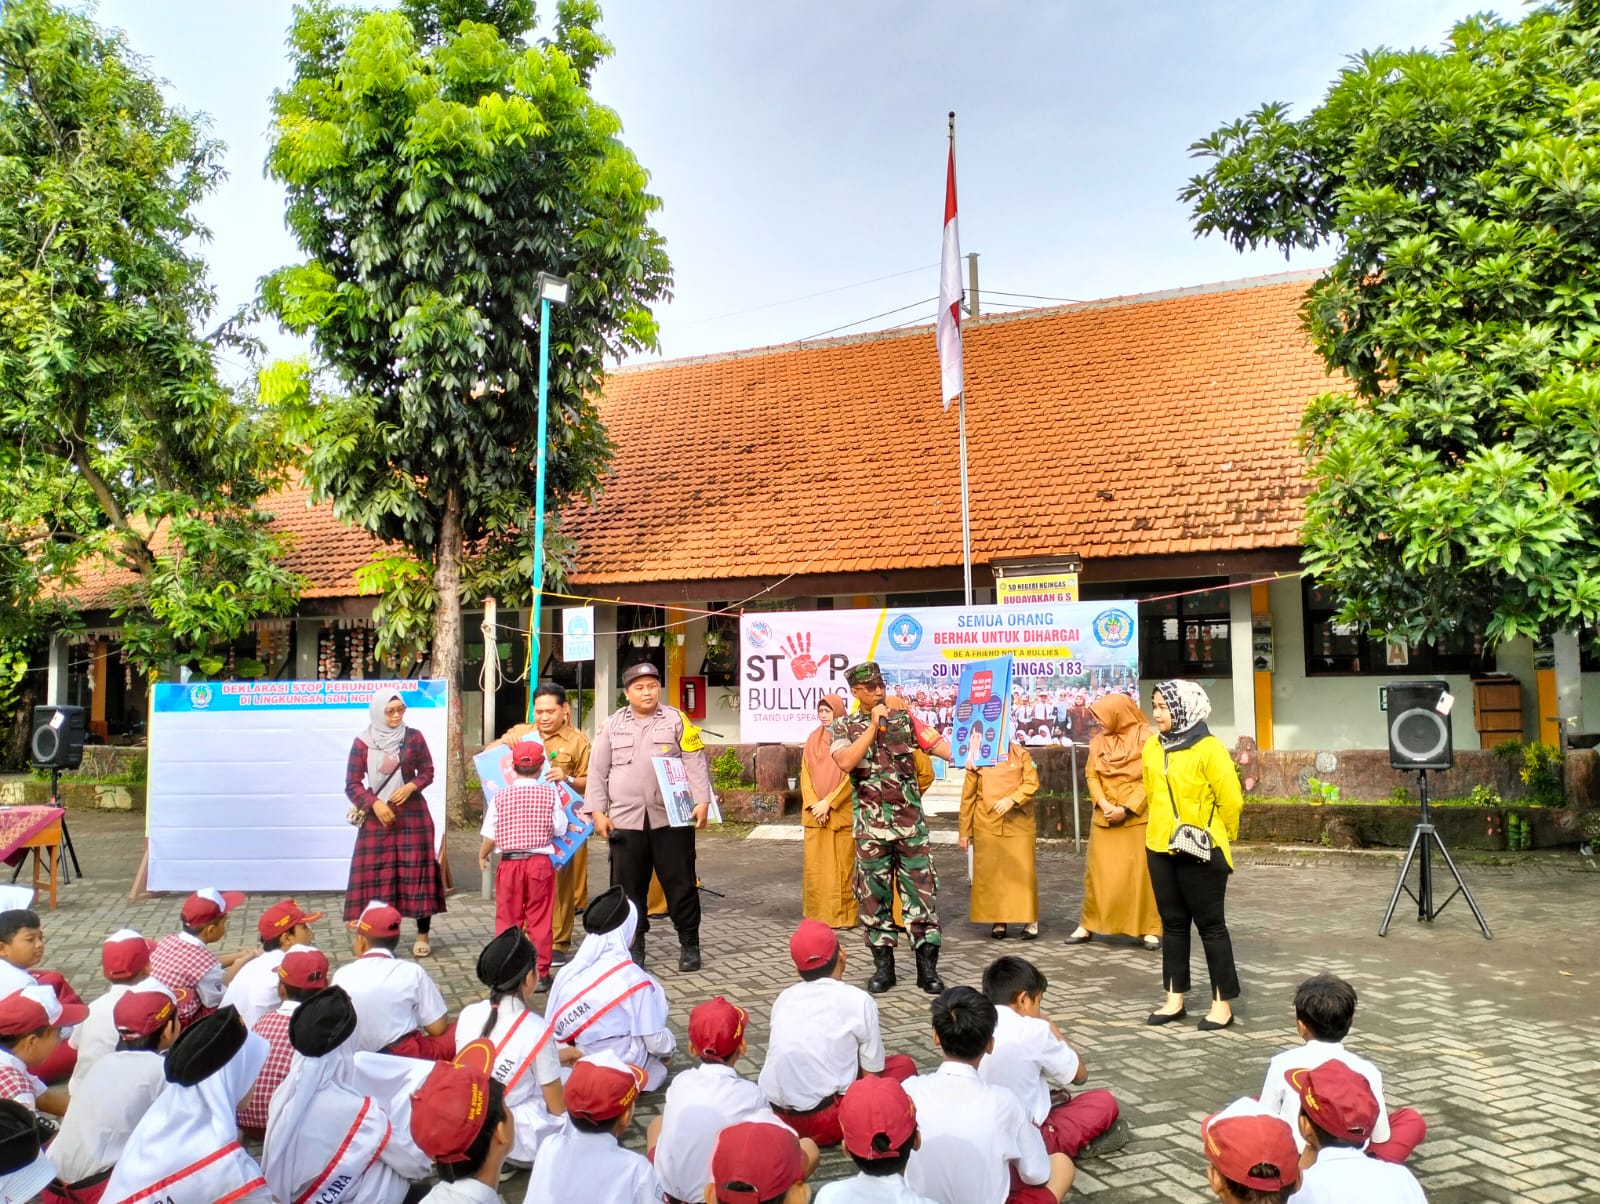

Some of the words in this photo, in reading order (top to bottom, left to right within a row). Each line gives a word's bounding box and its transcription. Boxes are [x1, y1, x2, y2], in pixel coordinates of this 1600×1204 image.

[1003, 593, 1055, 605] BUDAYAKAN
[957, 614, 1003, 628] SEMUA
[1007, 612, 1054, 626] ORANG
[934, 631, 978, 645] BERHAK
[982, 630, 1020, 644] UNTUK
[1023, 628, 1080, 643] DIHARGAI
[953, 650, 963, 658] BE
[932, 663, 947, 677] SD
[1059, 661, 1083, 676] 183
[223, 683, 288, 694] DEKLARASI
[292, 682, 322, 692] STOP
[240, 695, 251, 705] DI
[254, 694, 323, 705] LINGKUNGAN
[327, 694, 347, 703] SDN
[753, 713, 781, 722] STAND
[784, 713, 794, 722] UP
